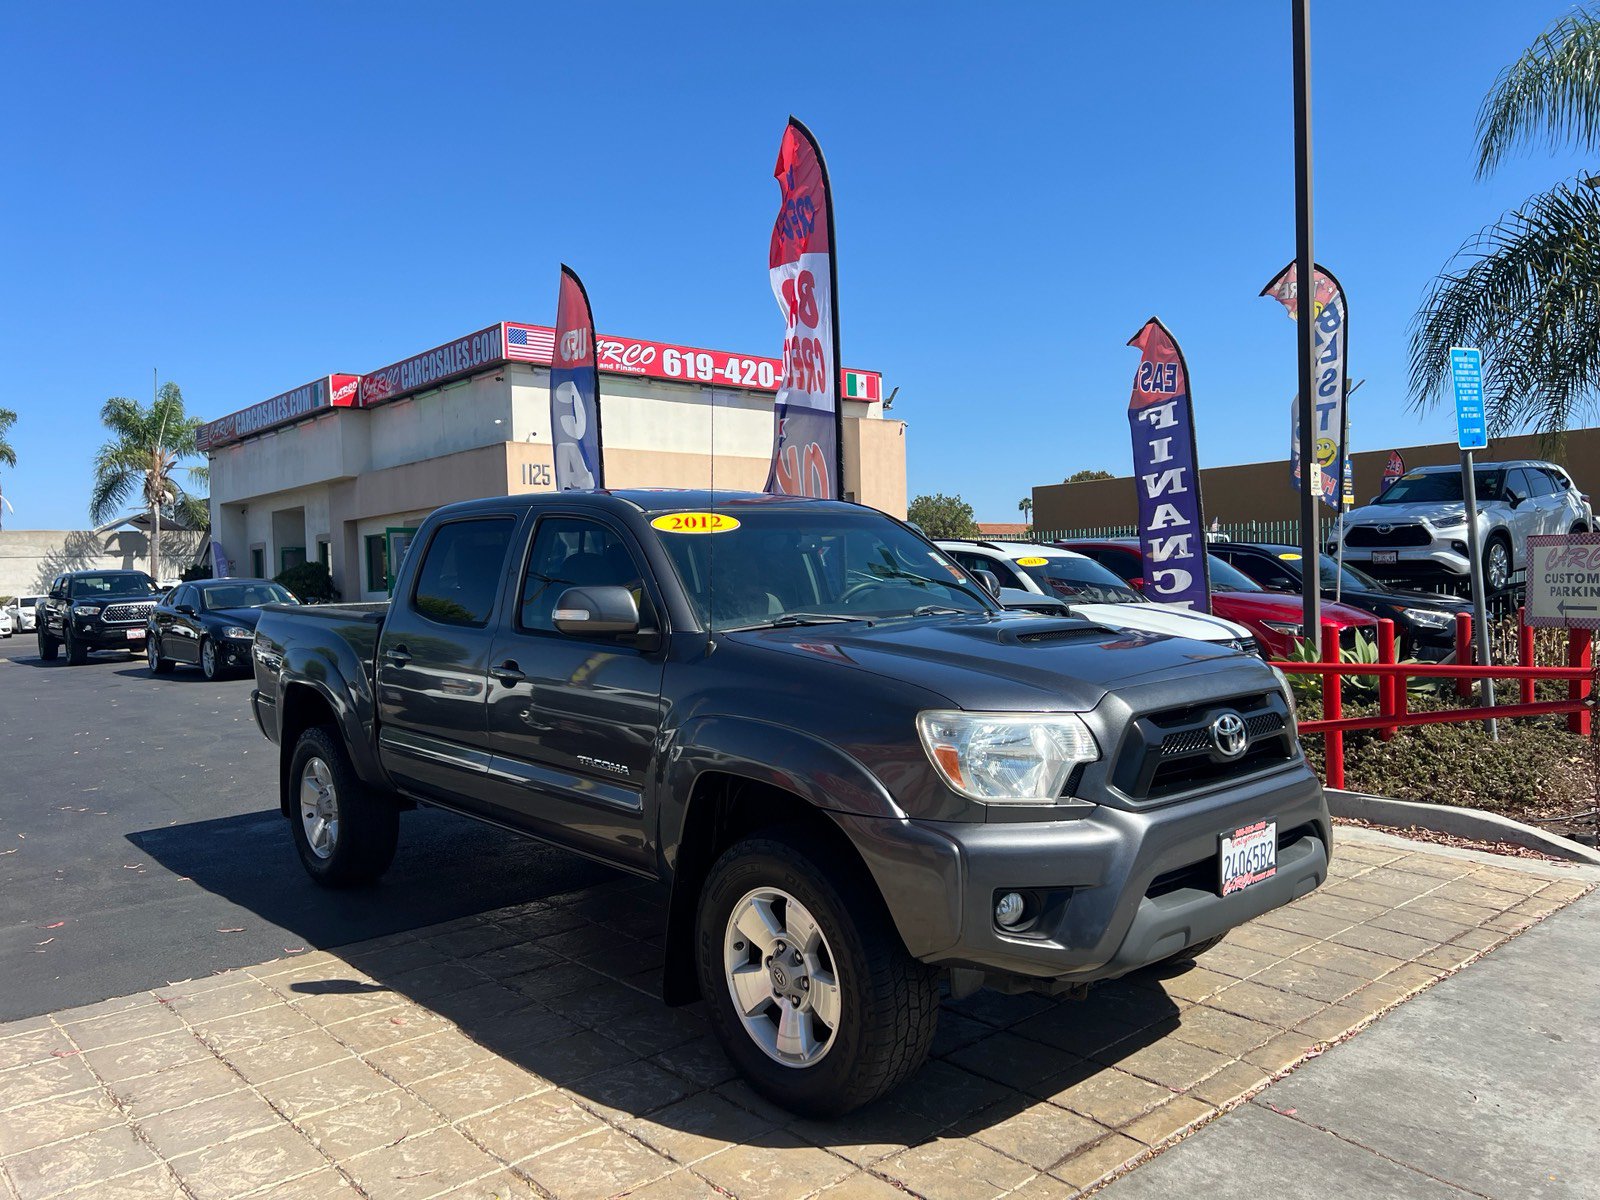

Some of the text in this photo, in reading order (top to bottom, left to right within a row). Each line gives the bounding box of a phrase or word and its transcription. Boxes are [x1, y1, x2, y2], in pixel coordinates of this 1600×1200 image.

[363, 328, 501, 399] CARCO CARCOSALES.COM
[616, 363, 646, 373] Finance
[663, 348, 783, 388] 619-420-
[332, 380, 358, 400] CARCO
[235, 386, 312, 436] CARCOSALES.COM
[522, 463, 550, 486] 1125
[671, 515, 723, 530] 2012
[577, 755, 630, 776] TACOMA
[1224, 841, 1274, 881] 24065B2
